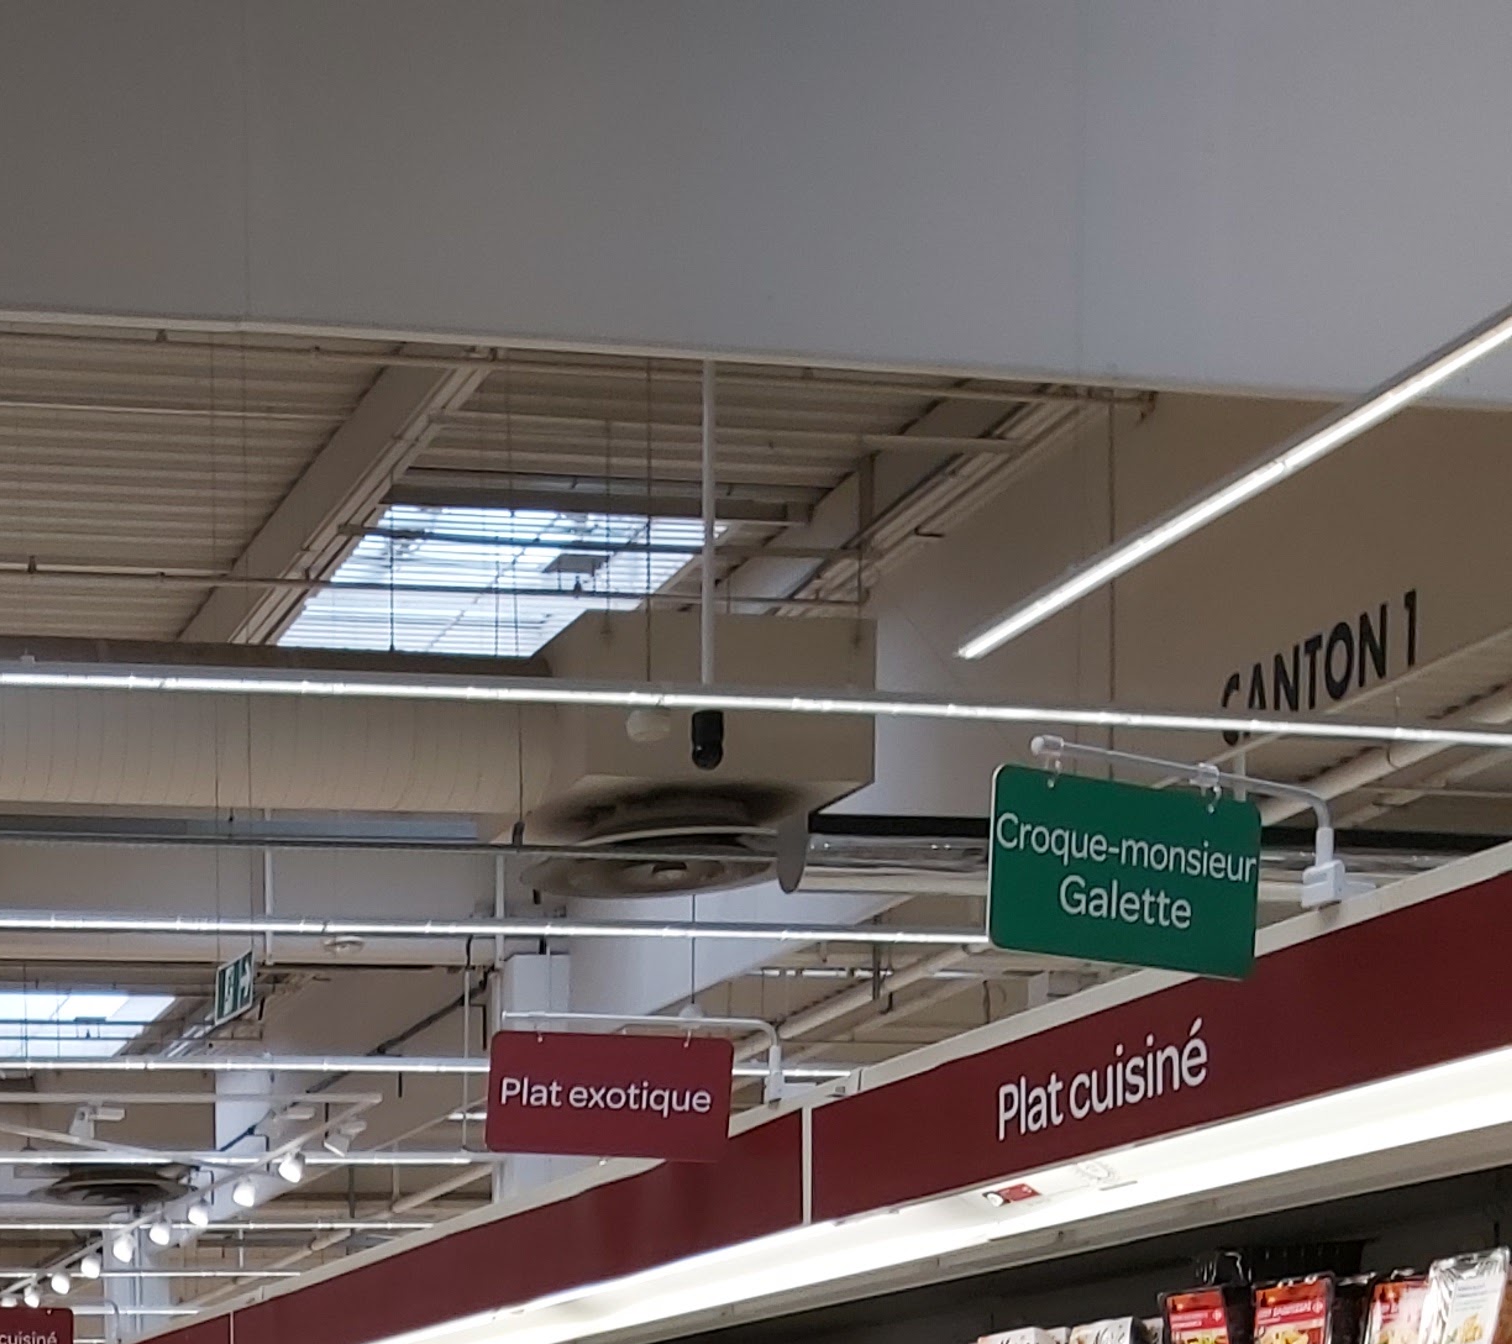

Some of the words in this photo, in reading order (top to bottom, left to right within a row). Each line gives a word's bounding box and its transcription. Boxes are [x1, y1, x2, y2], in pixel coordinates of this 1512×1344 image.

[1221, 603, 1387, 746] CANTON
[996, 812, 1258, 885] Croque-monsieur
[1059, 875, 1193, 931] Galette
[500, 1076, 562, 1107] Plat
[568, 1080, 713, 1117] exotique
[997, 1072, 1065, 1142] Plat
[1069, 1017, 1209, 1121] cuisiné
